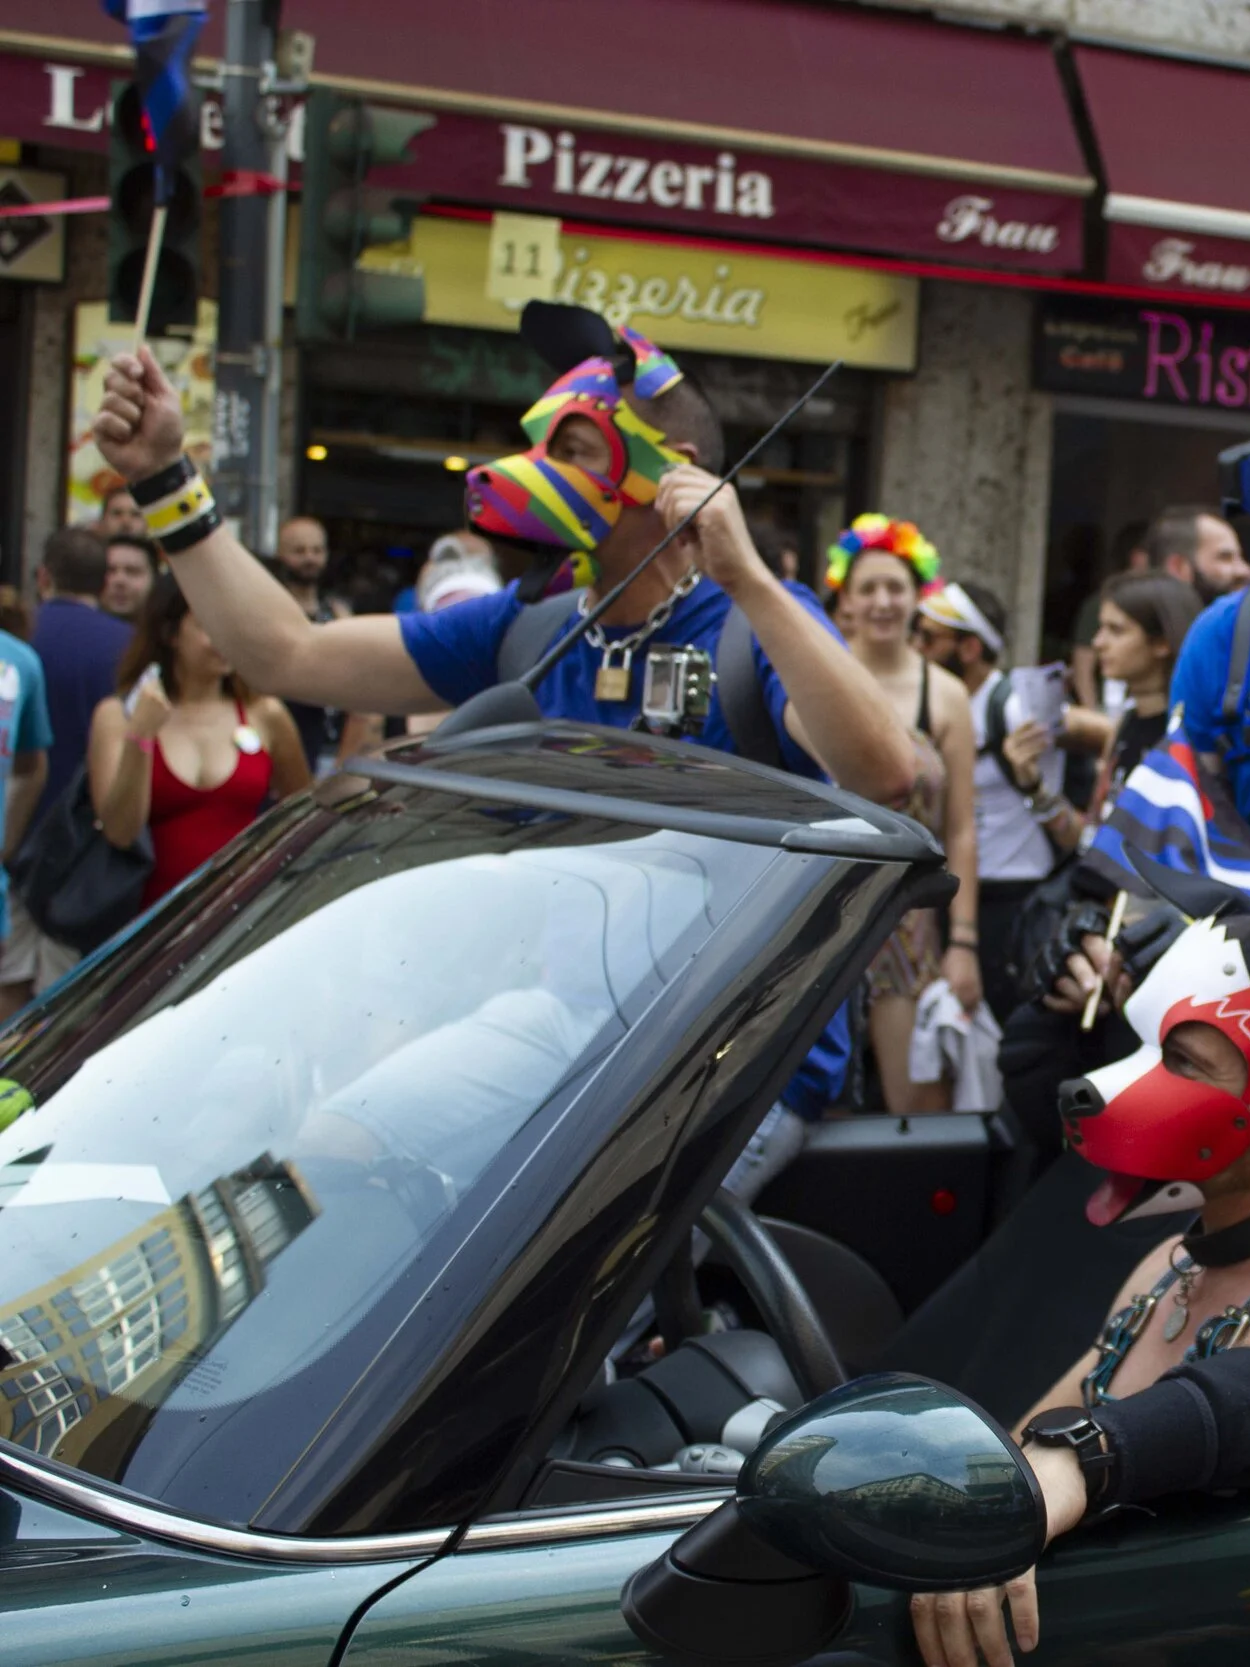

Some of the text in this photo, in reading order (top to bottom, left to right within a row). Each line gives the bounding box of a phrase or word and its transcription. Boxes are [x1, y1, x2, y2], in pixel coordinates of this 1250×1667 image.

[499, 125, 774, 218] Pizzeria
[937, 195, 1060, 253] Frau
[500, 240, 543, 278] 11
[504, 246, 764, 327] izzeria
